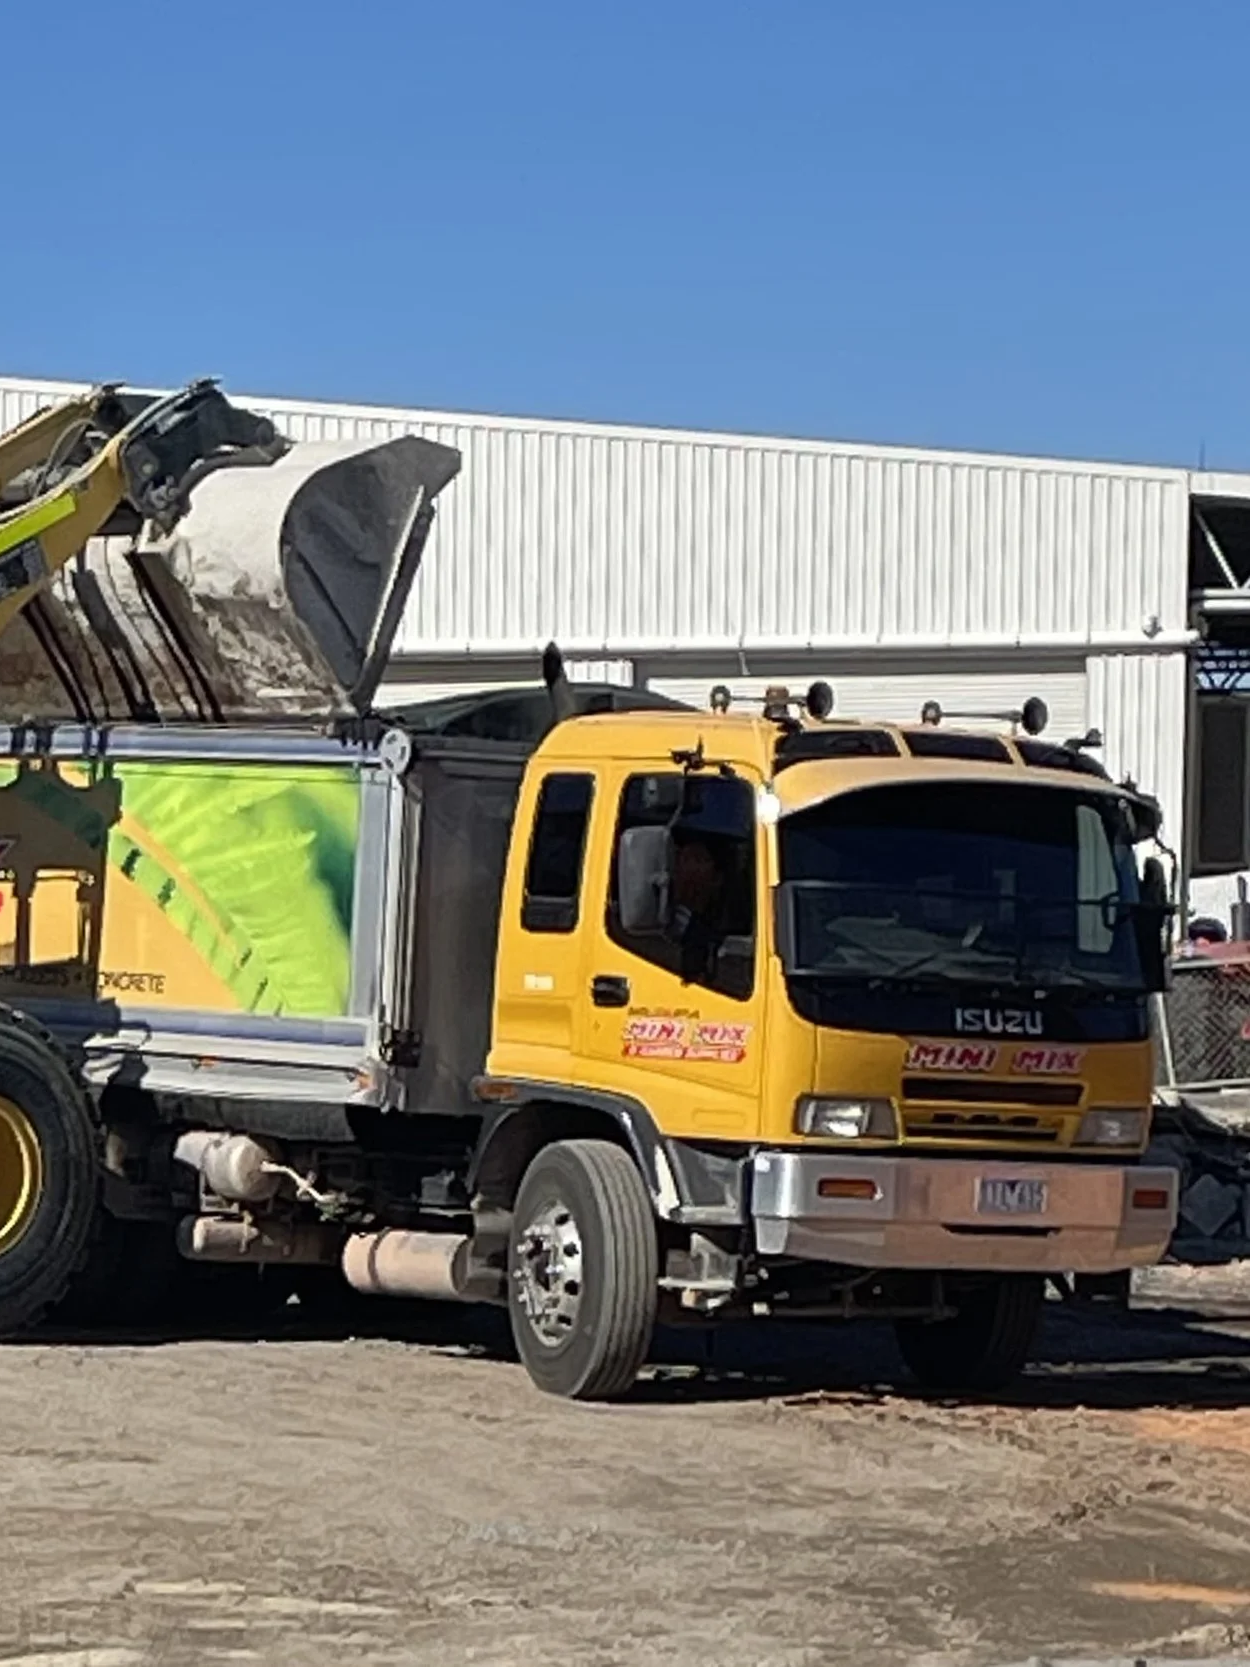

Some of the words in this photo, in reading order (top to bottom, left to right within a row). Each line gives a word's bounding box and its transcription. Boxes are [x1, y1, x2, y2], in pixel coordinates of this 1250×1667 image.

[625, 1020, 685, 1043] MINI
[693, 1023, 751, 1047] MIX
[955, 1008, 1043, 1035] ISUZU
[903, 1041, 1000, 1072] MINI
[1010, 1047, 1085, 1077] MIX
